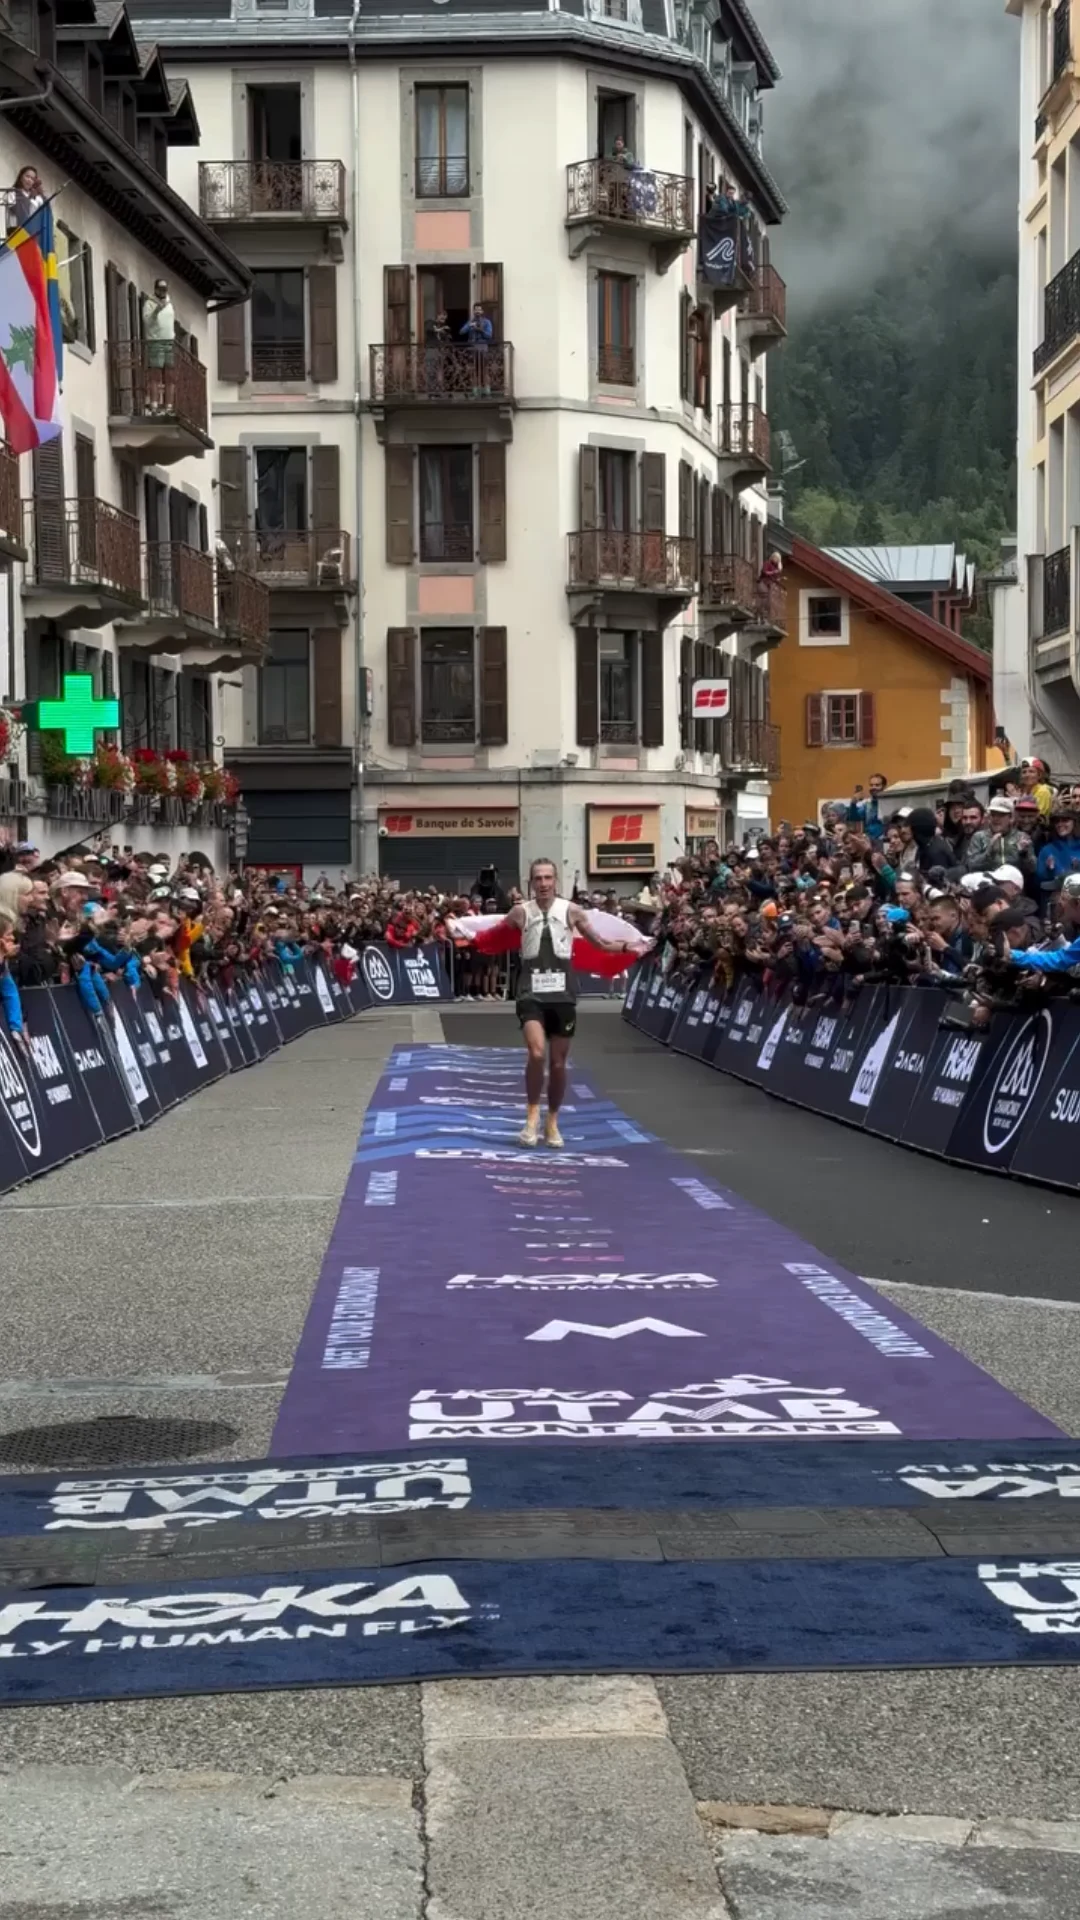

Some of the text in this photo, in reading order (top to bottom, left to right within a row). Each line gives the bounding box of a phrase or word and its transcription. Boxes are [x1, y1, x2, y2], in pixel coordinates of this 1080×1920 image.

[416, 817, 514, 830] Banque de Savoie
[893, 1050, 925, 1075] DACIA
[940, 1038, 983, 1083] HOKA
[446, 1272, 718, 1285] HOKA
[410, 1387, 635, 1401] HOKA
[409, 1398, 881, 1422] UTMB
[48, 1471, 472, 1515] UTMB
[257, 1496, 471, 1519] HOKA
[0, 1574, 471, 1635] HOKA
[83, 1622, 347, 1653] HUMAN
[362, 1614, 474, 1636] FLY
